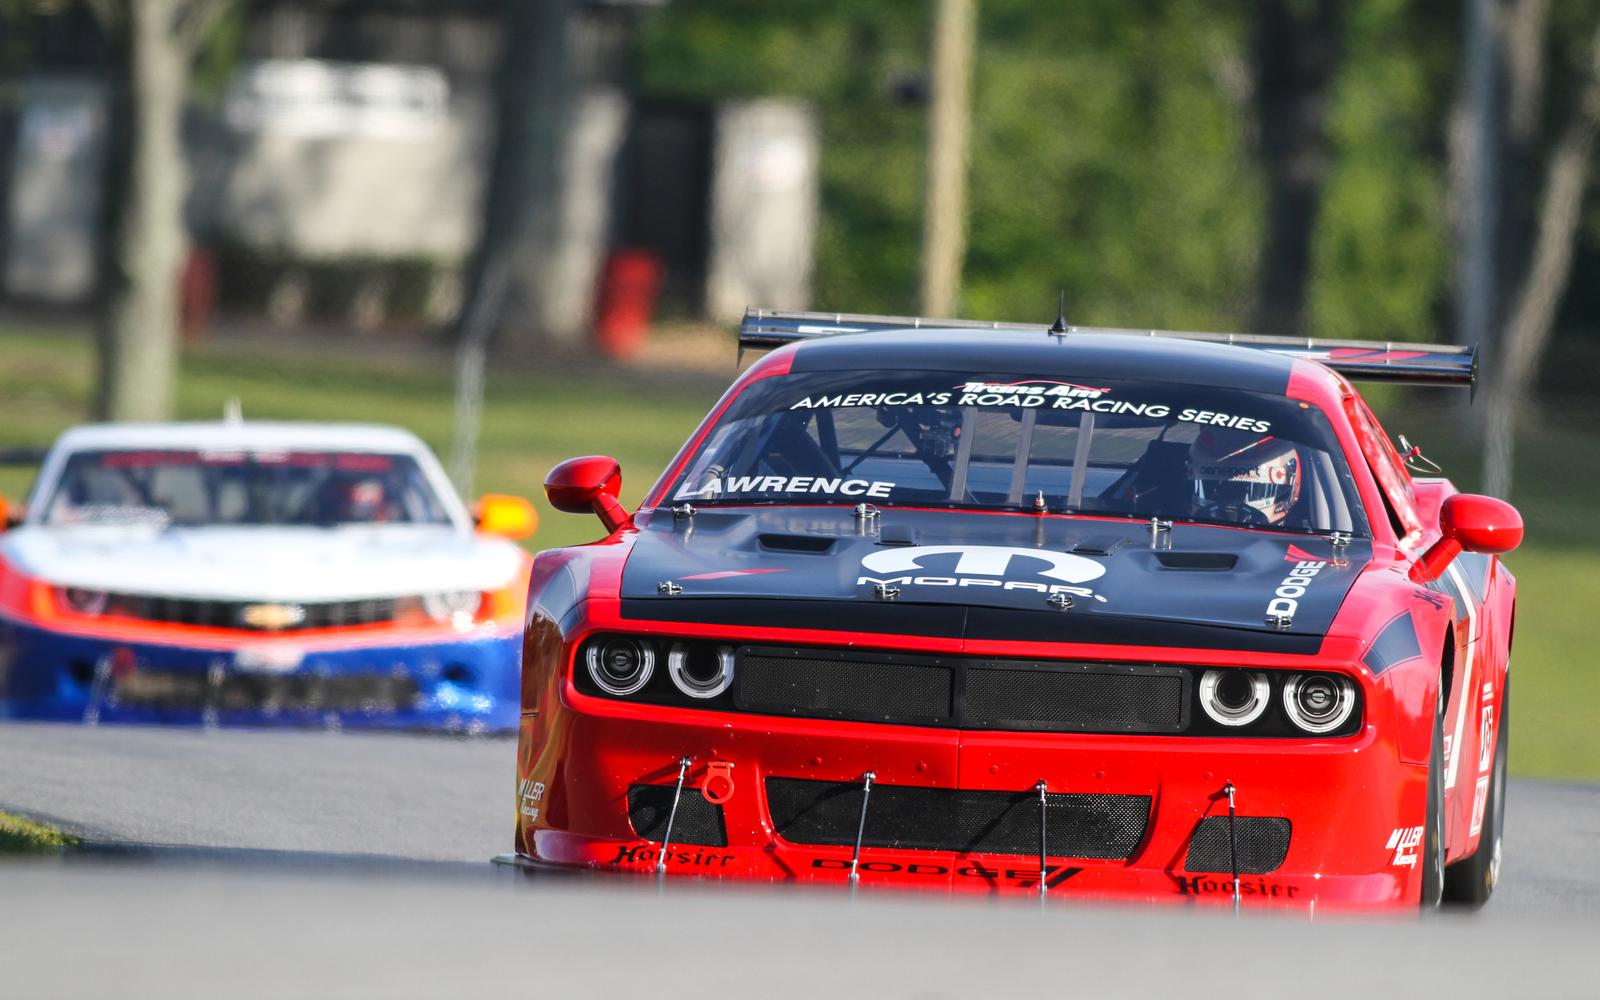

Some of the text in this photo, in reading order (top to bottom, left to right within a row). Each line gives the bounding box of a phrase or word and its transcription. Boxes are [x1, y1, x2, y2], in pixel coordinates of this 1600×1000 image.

[790, 392, 1271, 433] AMERICA'S ROAD RACING SERIES
[673, 476, 896, 501] LAWRENCE
[1266, 560, 1327, 618] DODGE
[811, 858, 1048, 879] DODGE
[1173, 875, 1300, 897] Hoosier
